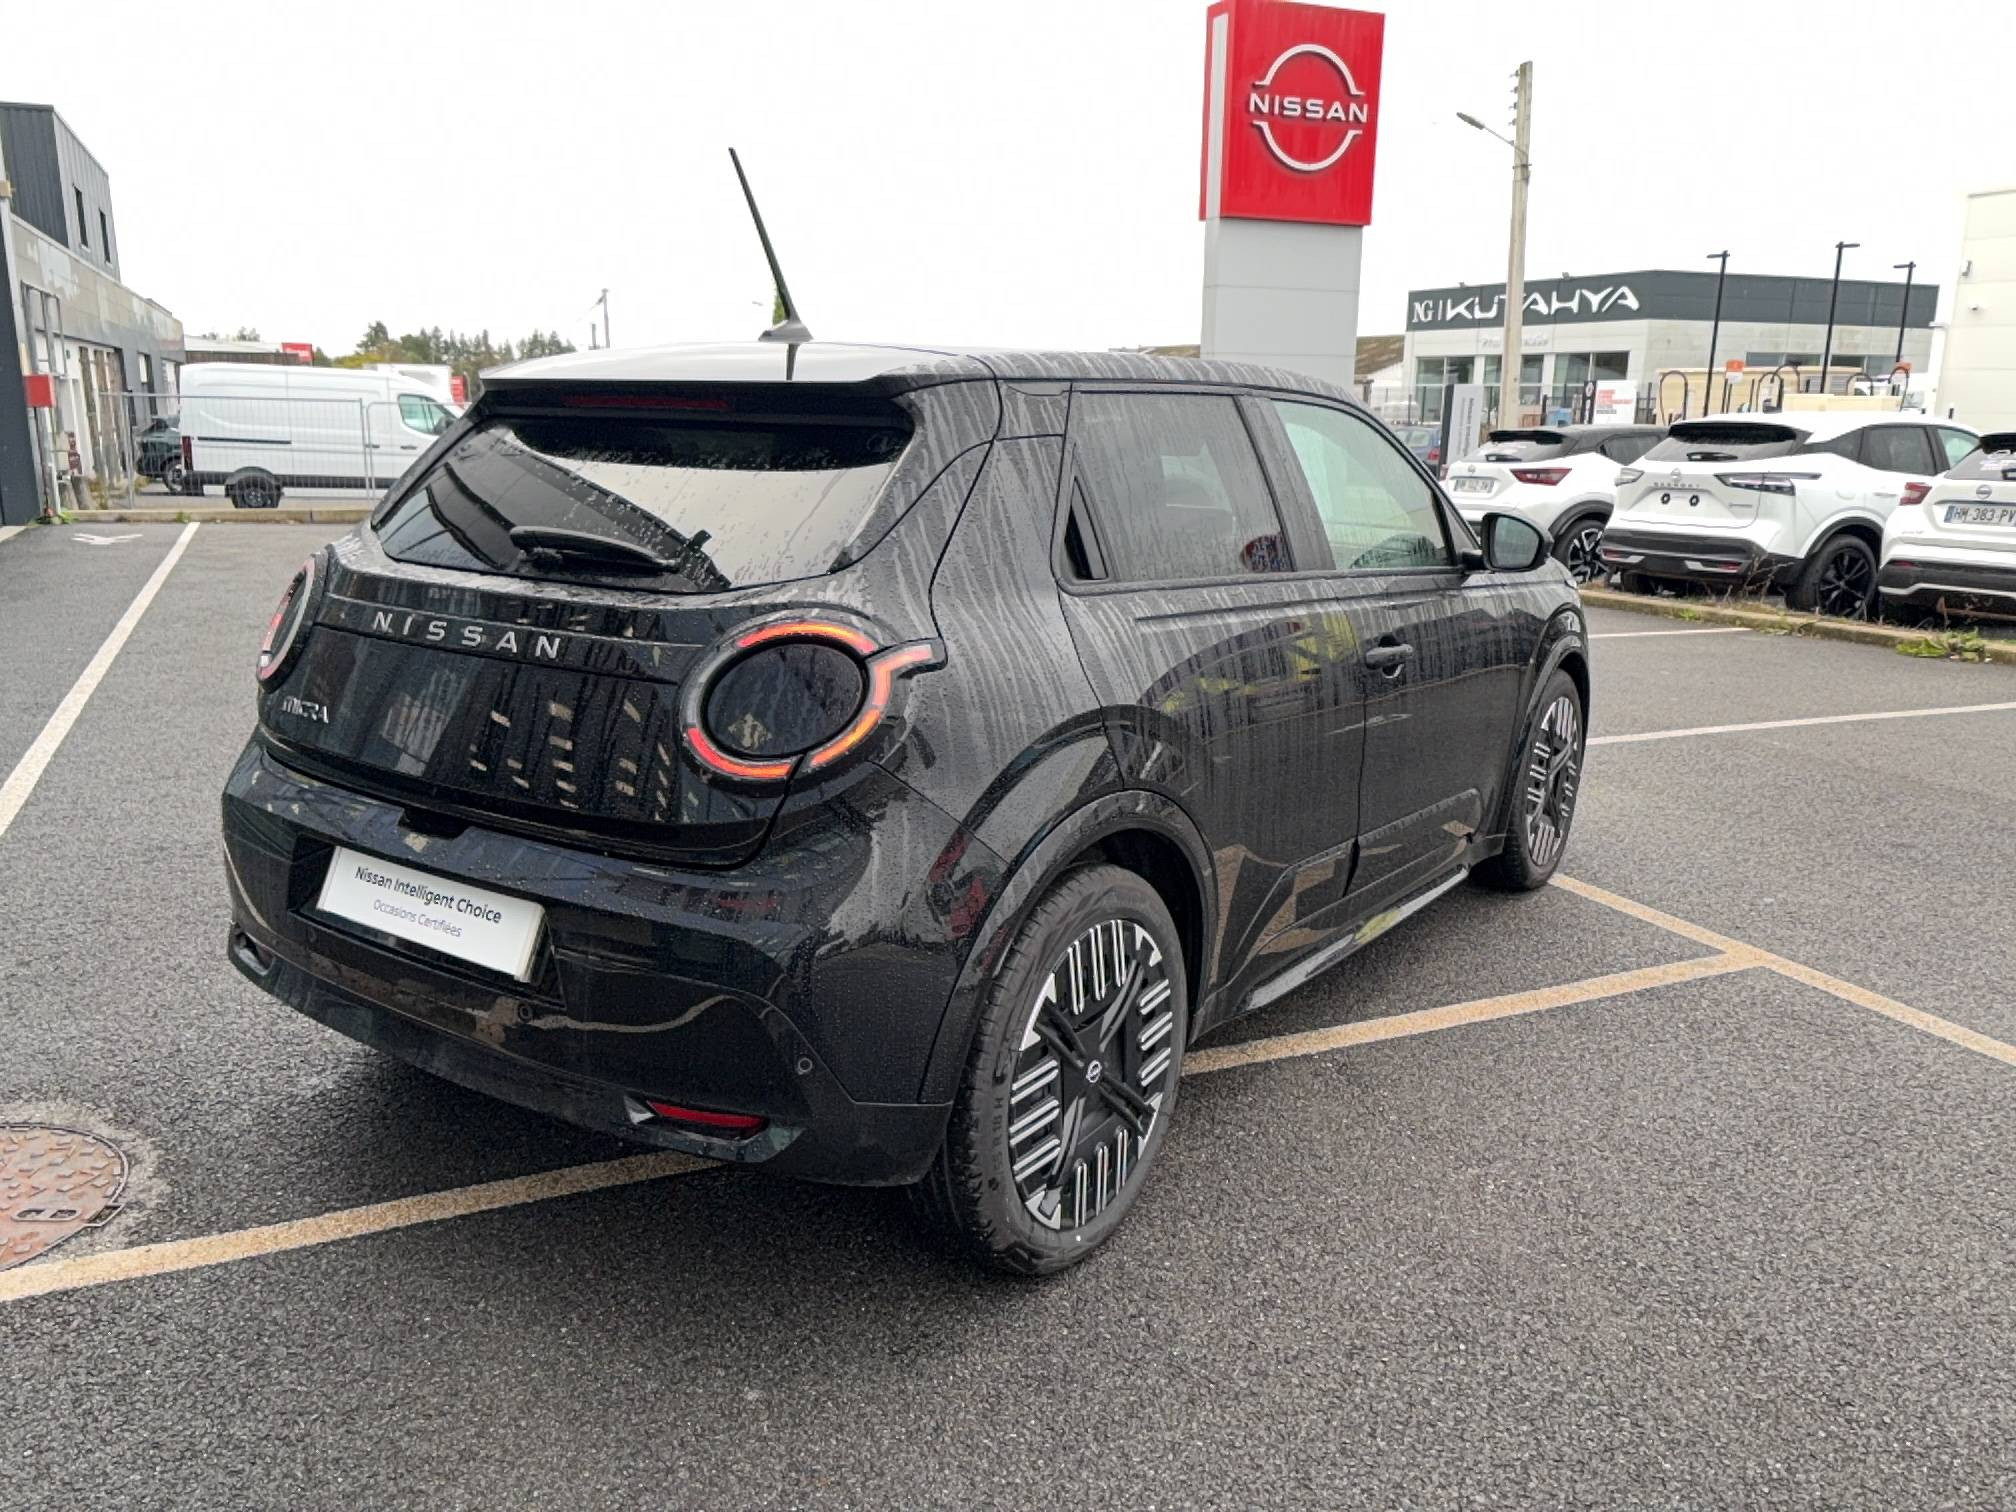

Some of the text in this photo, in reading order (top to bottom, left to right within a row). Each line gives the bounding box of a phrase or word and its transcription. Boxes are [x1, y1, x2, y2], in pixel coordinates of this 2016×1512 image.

[1249, 92, 1368, 123] NISSAN
[1411, 300, 1434, 323] NG
[372, 611, 561, 659] NISSAN
[355, 866, 502, 924] Nissan Intelligent Choice
[373, 899, 462, 938] Occasions Certifiées
